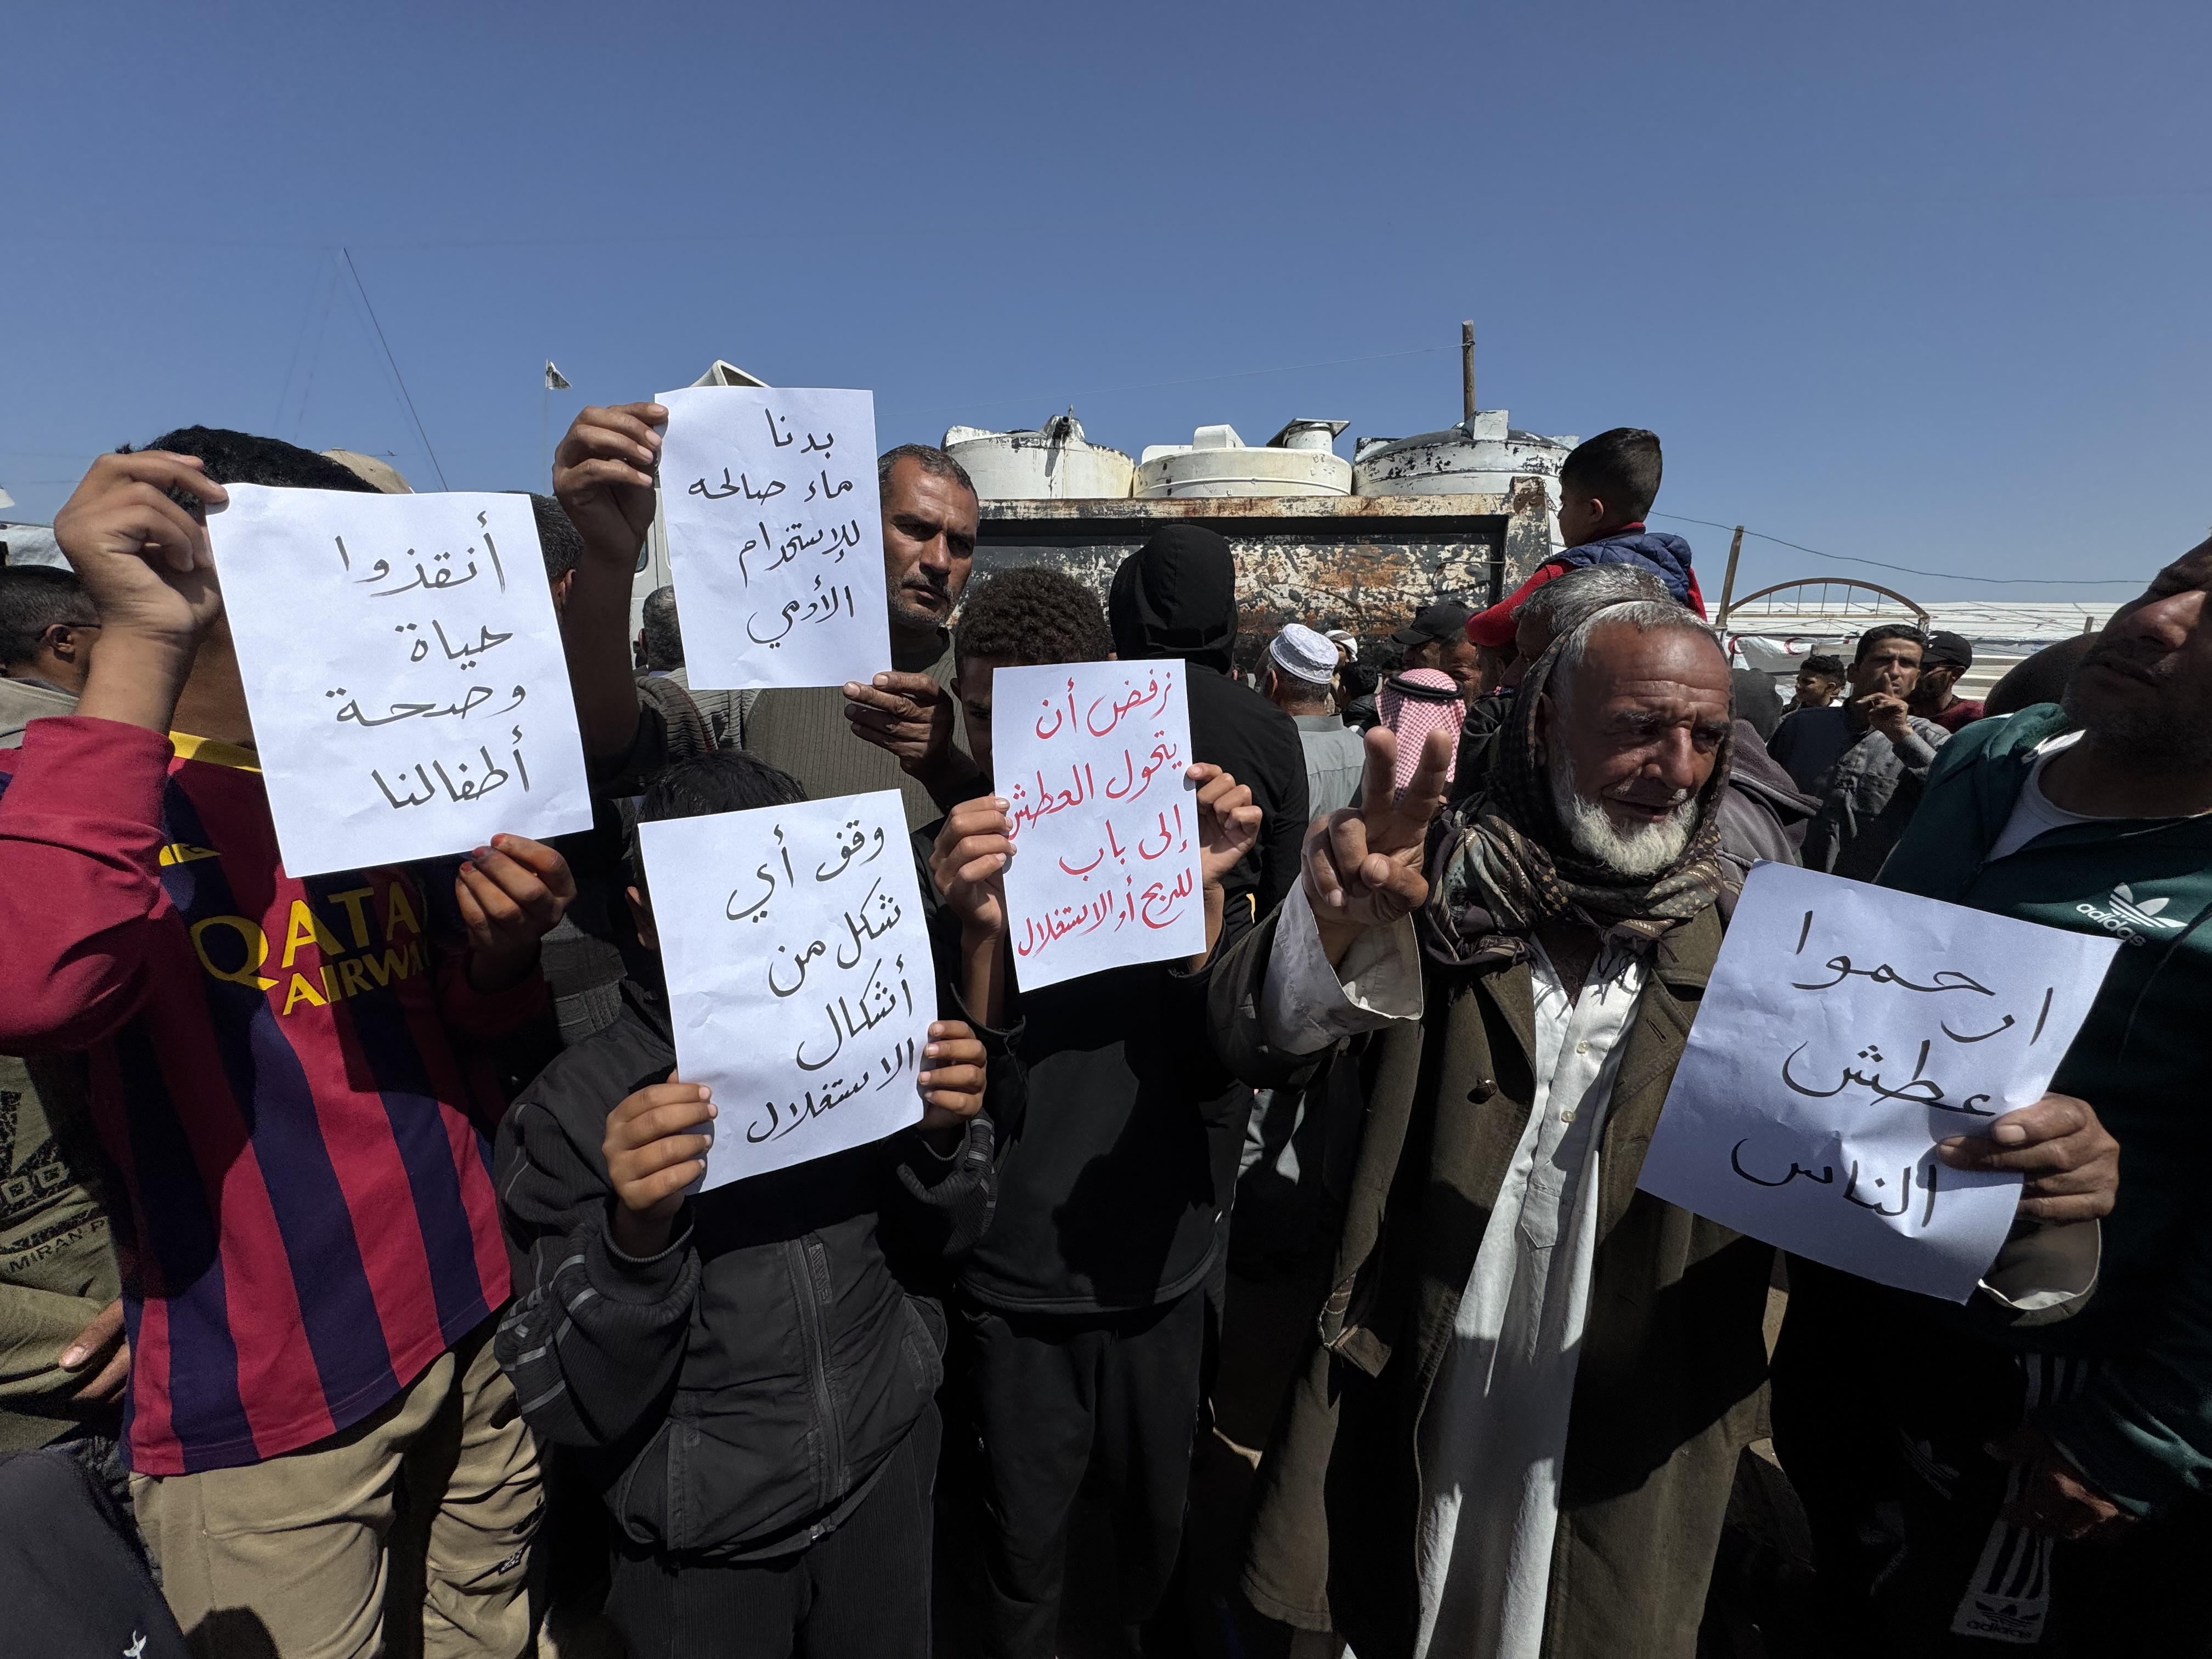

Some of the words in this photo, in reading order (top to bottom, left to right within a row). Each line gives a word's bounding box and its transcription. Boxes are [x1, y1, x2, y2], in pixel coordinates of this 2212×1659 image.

[765, 408, 834, 460] بدنا
[803, 469, 854, 503] ماء
[334, 510, 505, 599] أنقذوا
[394, 619, 514, 671] حياة
[325, 685, 527, 727] وصحة
[1035, 676, 1077, 740] أن
[371, 724, 530, 810] أطفالنا
[1105, 730, 1183, 804] يتحول
[1008, 762, 1094, 840] العطش
[1138, 803, 1188, 861] إلى
[726, 823, 794, 923] أي
[815, 820, 885, 883] وقف
[1058, 819, 1127, 882] باب
[837, 876, 902, 970] شكل
[1017, 889, 1114, 959] الاستغلال
[1114, 873, 1135, 933] أو
[1140, 867, 1194, 929] للربح
[2075, 903, 2147, 947] adidas
[189, 880, 430, 991] QATA
[768, 939, 827, 998] من
[796, 953, 913, 1071] أشكال
[746, 1036, 915, 1143] الاستغلال
[1782, 1038, 1997, 1117] عطش
[1730, 1138, 1942, 1228] الناس
